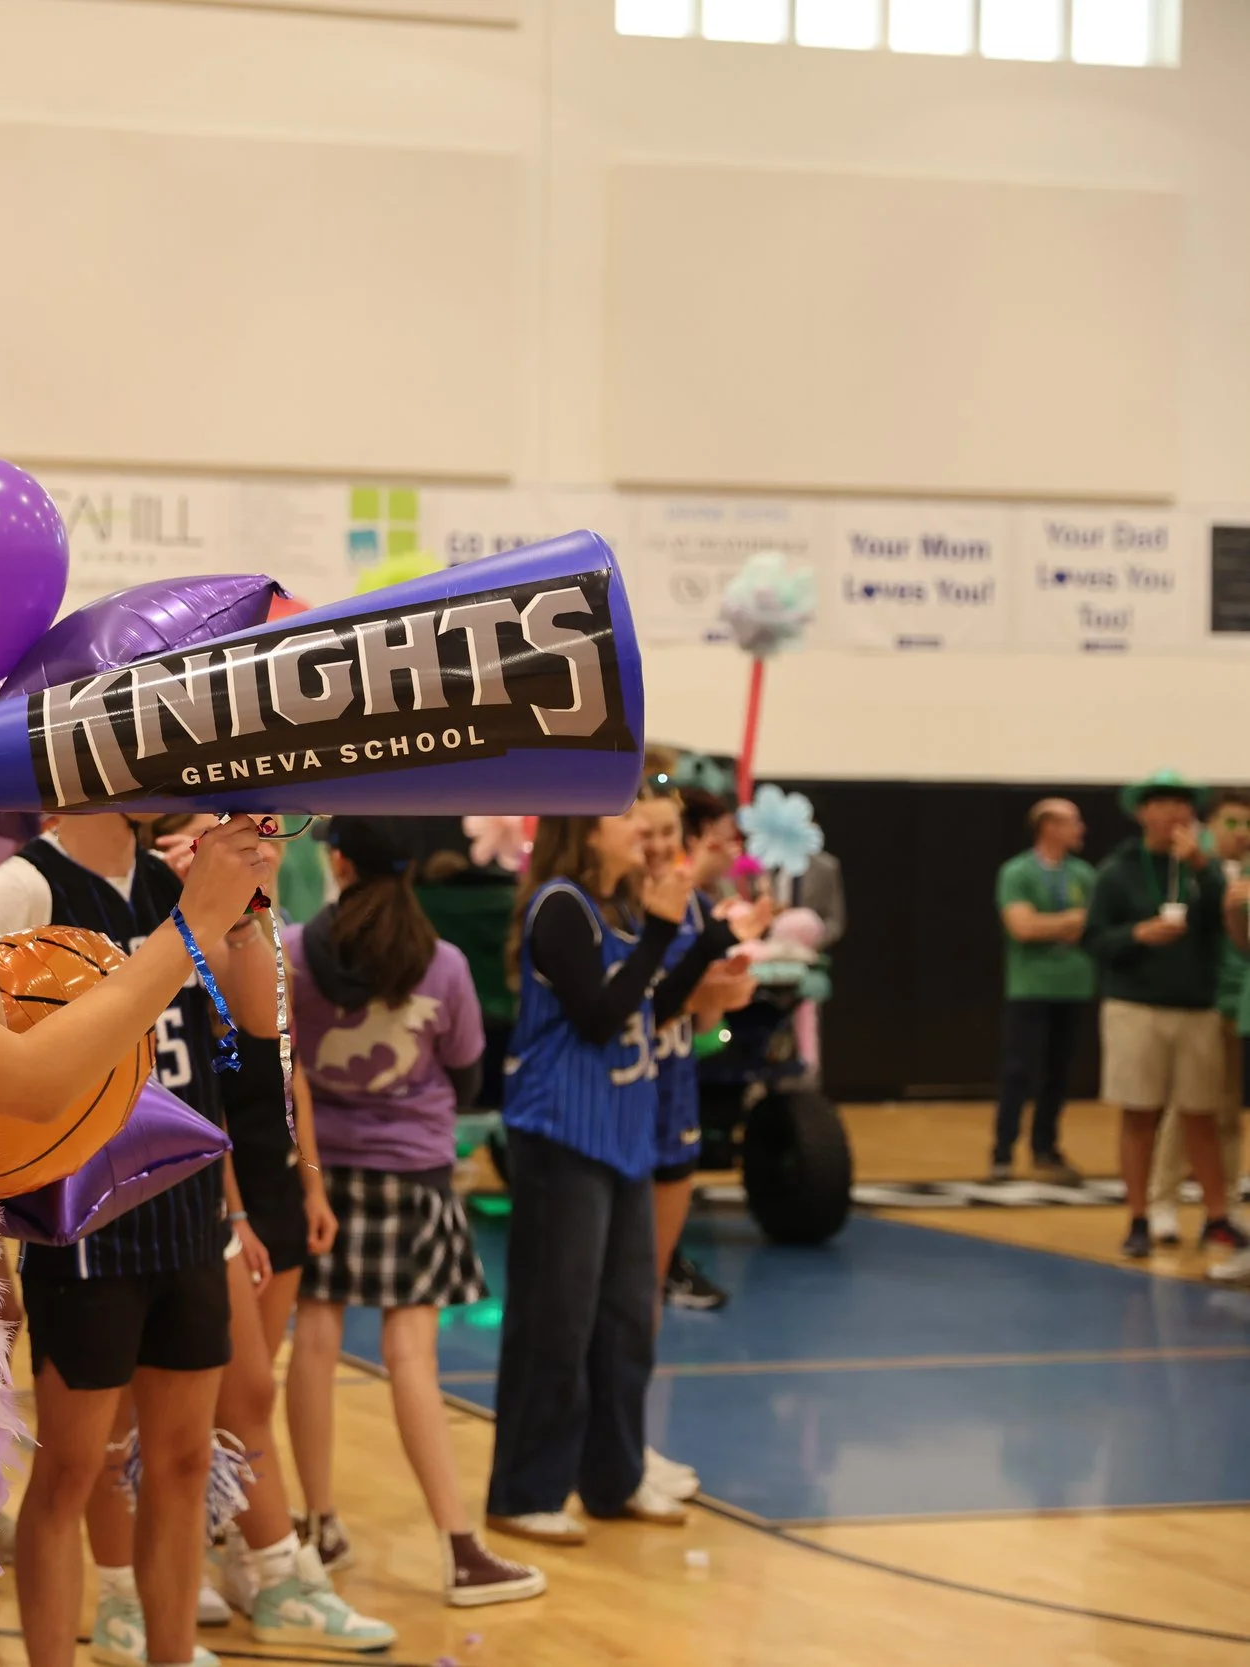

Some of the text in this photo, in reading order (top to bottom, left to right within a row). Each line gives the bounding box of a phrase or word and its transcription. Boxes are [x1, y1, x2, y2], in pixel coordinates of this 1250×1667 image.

[43, 586, 608, 808] KNIGHTS
[181, 725, 485, 785] GENEVA SCHOOL
